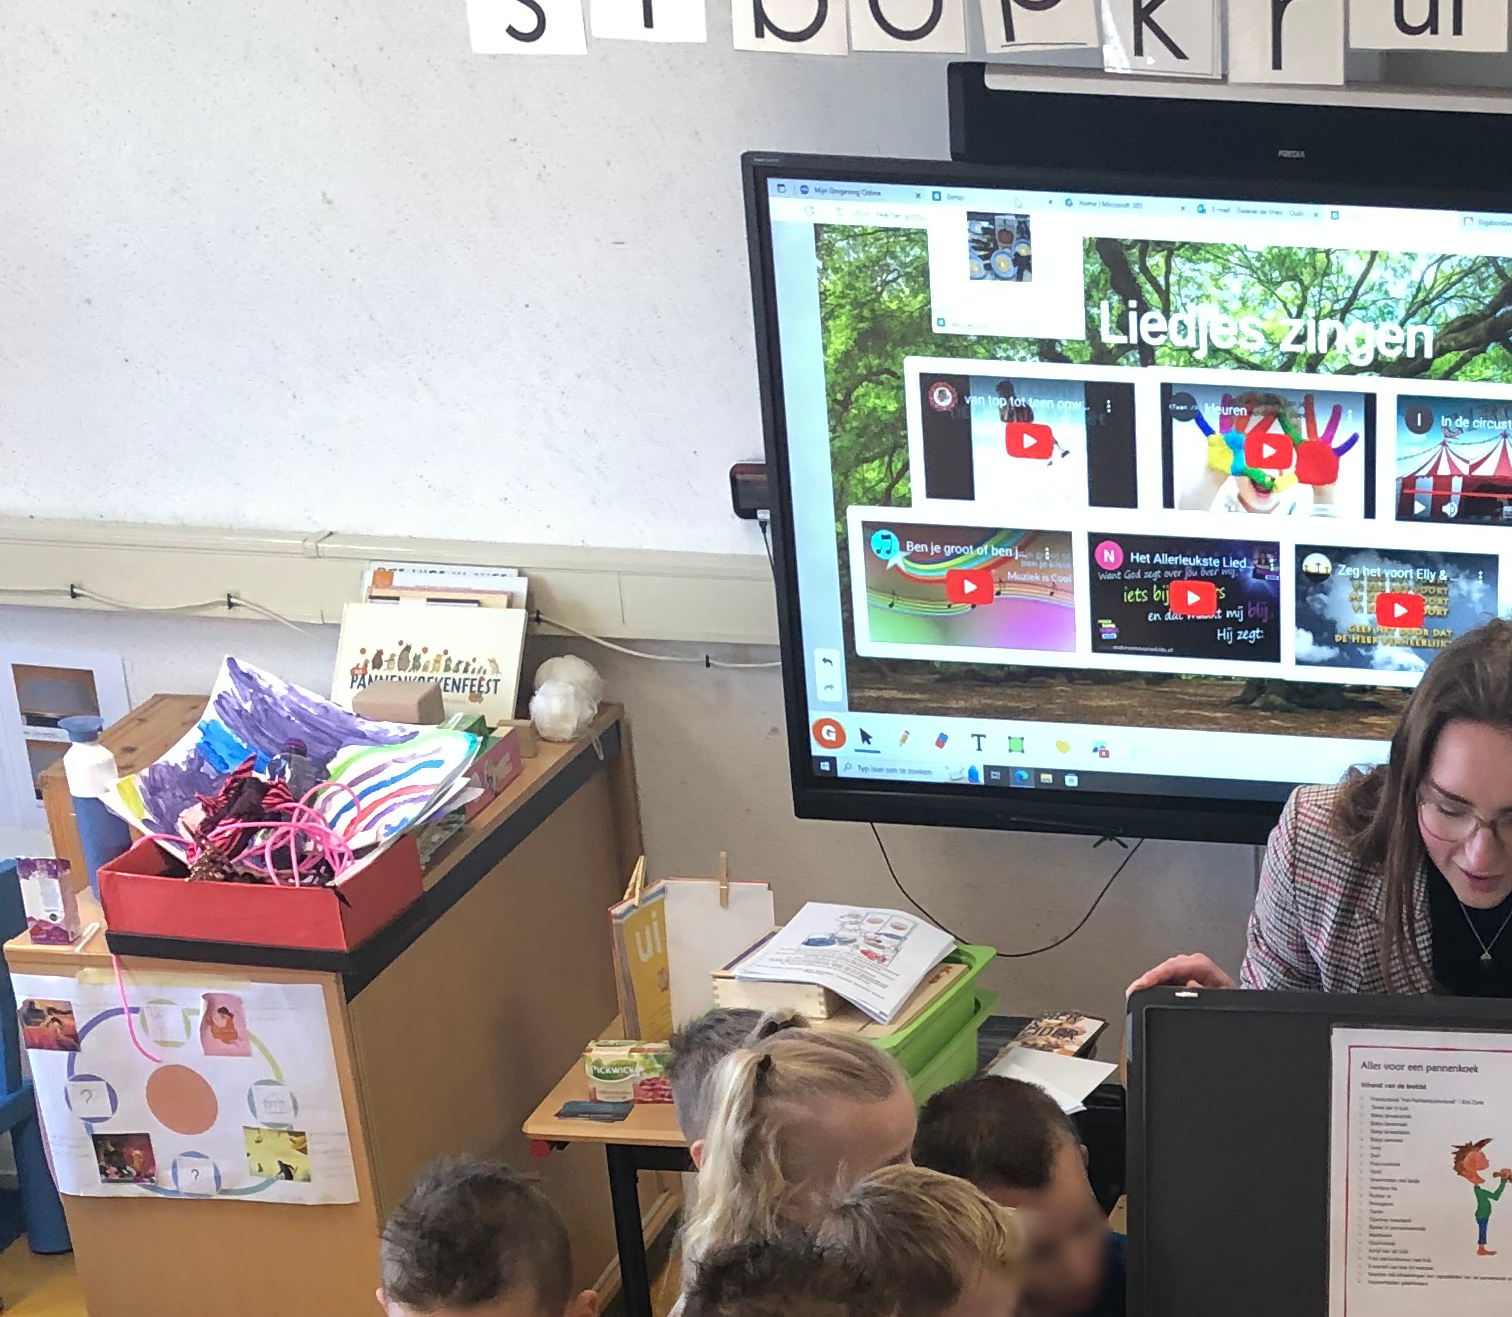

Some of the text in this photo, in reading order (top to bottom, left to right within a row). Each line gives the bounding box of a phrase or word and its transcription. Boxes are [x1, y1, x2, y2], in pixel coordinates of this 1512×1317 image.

[1100, 299, 1434, 366] Liedjes zingen
[963, 394, 985, 406] van
[988, 395, 1006, 408] top
[1009, 396, 1027, 408] tot
[1029, 397, 1054, 409] teen
[1203, 402, 1248, 417] kleuren
[1440, 415, 1452, 427] In
[1456, 415, 1470, 428] de
[906, 540, 929, 553] Ben
[930, 541, 941, 556] je
[943, 542, 973, 558] groot
[976, 543, 989, 556] of
[990, 544, 1012, 558] ben
[1103, 549, 1115, 564] N
[1130, 551, 1150, 564] Het
[1153, 552, 1220, 568] Allerleukste
[1007, 571, 1072, 584] Muziek is Cool
[1123, 568, 1141, 580] God
[1143, 570, 1162, 582] zegt
[1163, 569, 1181, 579] over
[1200, 568, 1218, 578] over
[1337, 563, 1448, 583] Zeg het voort Elly &
[1123, 585, 1148, 603] iets
[1147, 611, 1162, 622] en
[1225, 605, 1245, 622] mij
[1216, 626, 1234, 645] Hij
[857, 764, 869, 774] Typ
[907, 767, 933, 776] zoeken
[635, 910, 663, 964] ui
[591, 1064, 637, 1077] PICKWICK
[1360, 1061, 1479, 1074] Alles voor een pannenkoek
